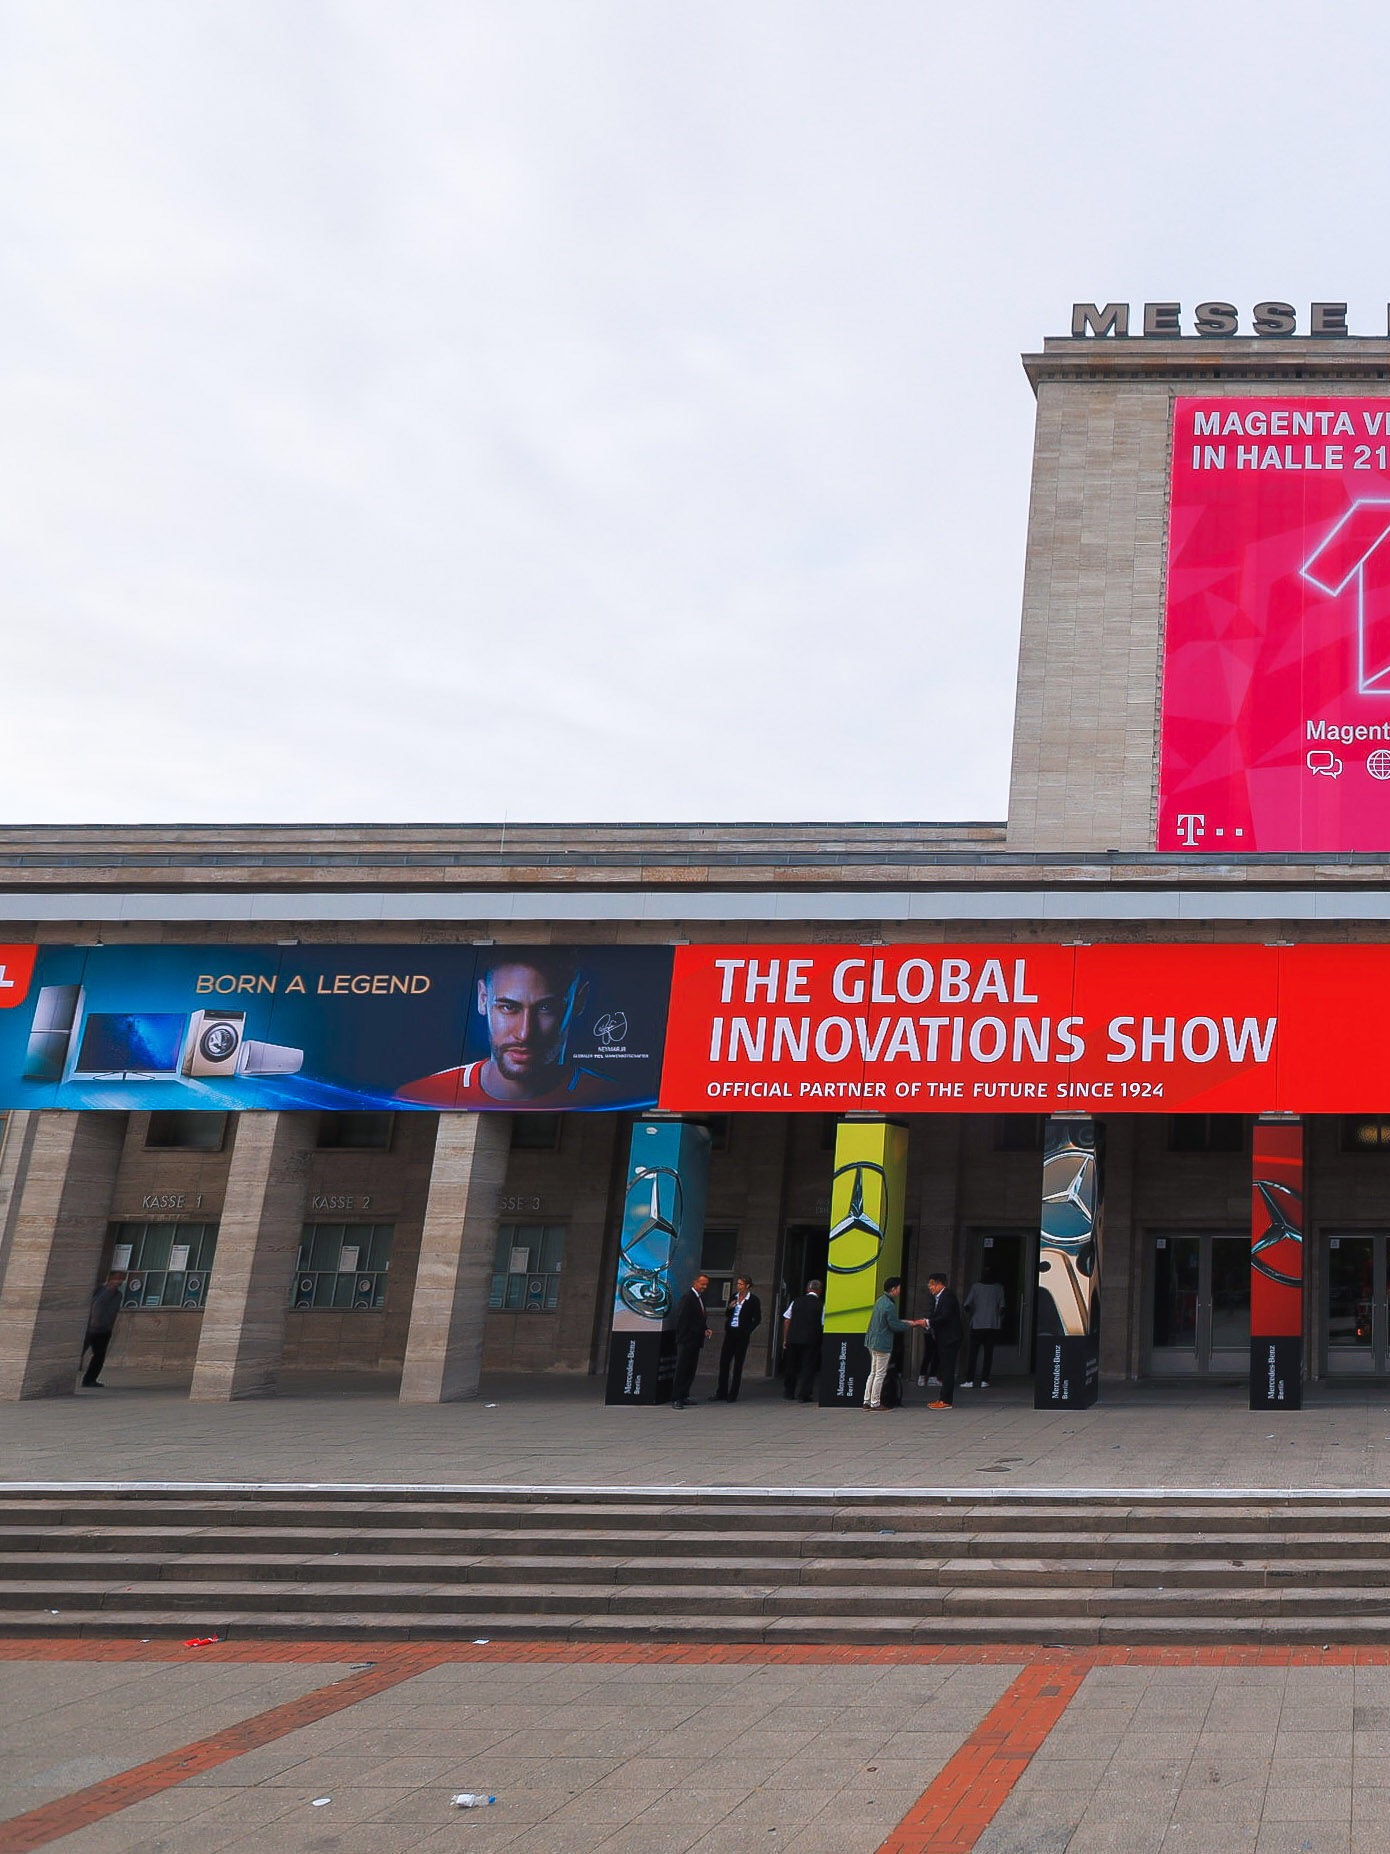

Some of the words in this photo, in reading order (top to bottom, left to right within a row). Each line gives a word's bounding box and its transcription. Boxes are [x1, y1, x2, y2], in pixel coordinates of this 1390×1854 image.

[1071, 302, 1348, 337] MESSE
[1194, 412, 1355, 436] MAGENTA
[1192, 445, 1225, 469] IN
[1237, 445, 1343, 470] HALLE
[196, 975, 278, 994] BORN
[284, 975, 306, 994] A
[317, 975, 431, 994] LEGEND
[714, 959, 814, 1003] THE
[832, 958, 1038, 1004] GLOBAL
[709, 1015, 1086, 1063] INNOVATIONS
[1106, 1015, 1277, 1063] SHOW
[707, 1082, 793, 1097] OFFICIAL
[799, 1082, 887, 1097] PARTNER
[895, 1082, 921, 1097] OF
[926, 1082, 964, 1097] THE
[973, 1082, 1048, 1097] FUTURE
[1057, 1082, 1114, 1097] SINCE
[1121, 1082, 1164, 1097] 1924
[142, 1195, 185, 1209] KASSE
[196, 1195, 203, 1208] 1
[312, 1196, 353, 1209] KASSE
[361, 1196, 371, 1209] 2
[500, 1197, 527, 1209] SSE
[532, 1197, 541, 1209] 3
[624, 1340, 636, 1394] Mercedes-Benz
[837, 1342, 847, 1396] Mercedes-Benz
[1052, 1344, 1061, 1398] Mercedes-Benz
[1268, 1345, 1276, 1399] Mercedes-Benz
